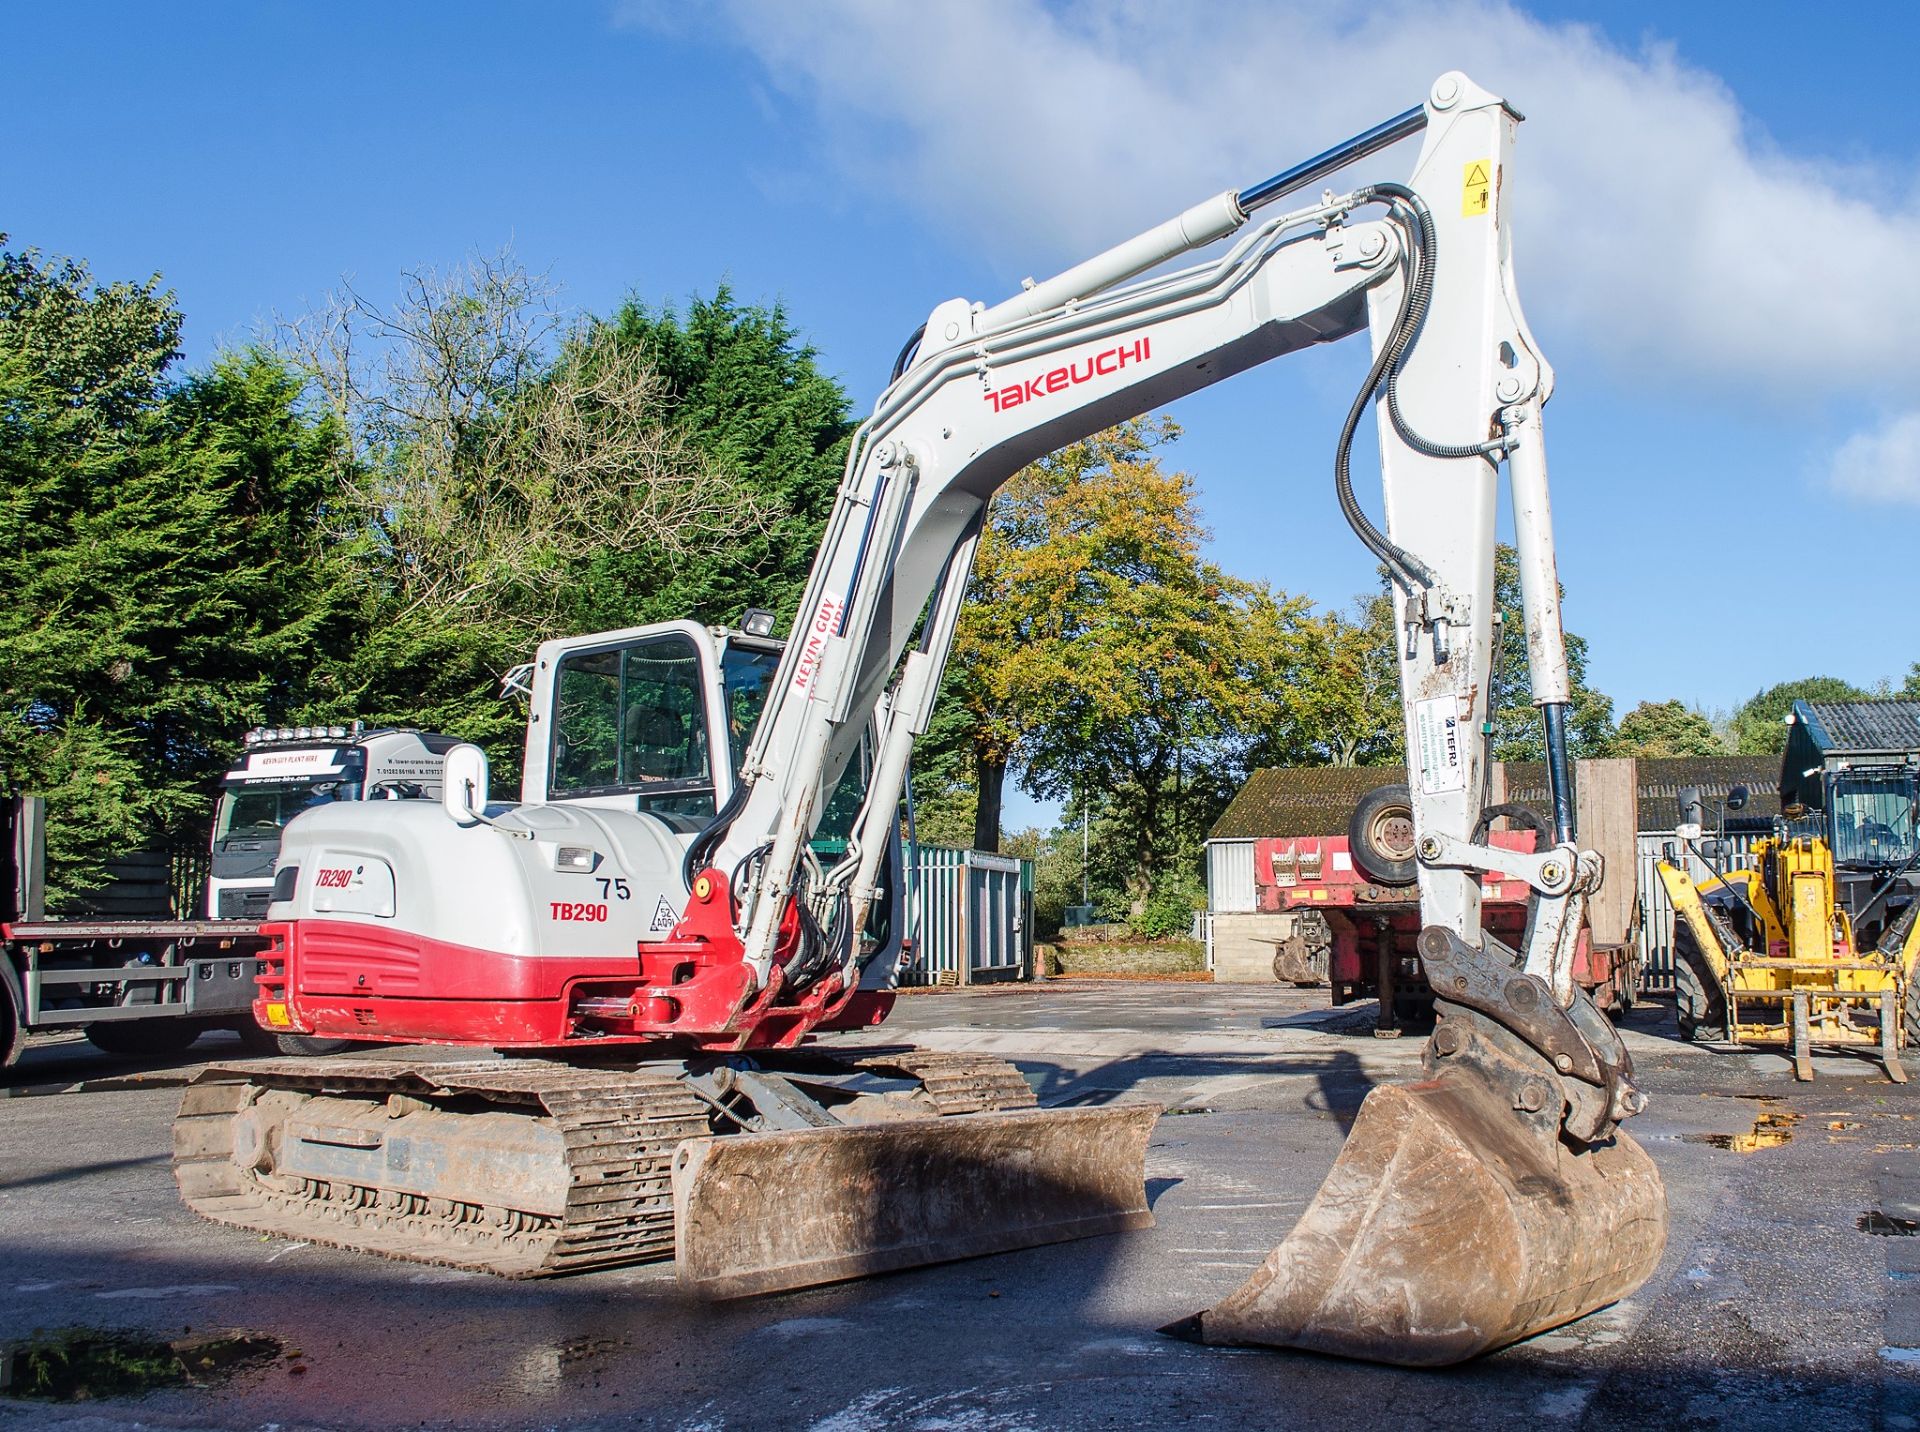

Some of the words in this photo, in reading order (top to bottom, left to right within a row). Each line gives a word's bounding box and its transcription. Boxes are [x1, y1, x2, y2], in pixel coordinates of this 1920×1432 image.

[796, 636, 821, 688] KEVIN
[815, 598, 835, 633] GUY
[315, 868, 353, 888] TB290
[595, 878, 631, 901] 75
[550, 902, 608, 922] TB290
[660, 908, 671, 917] 52
